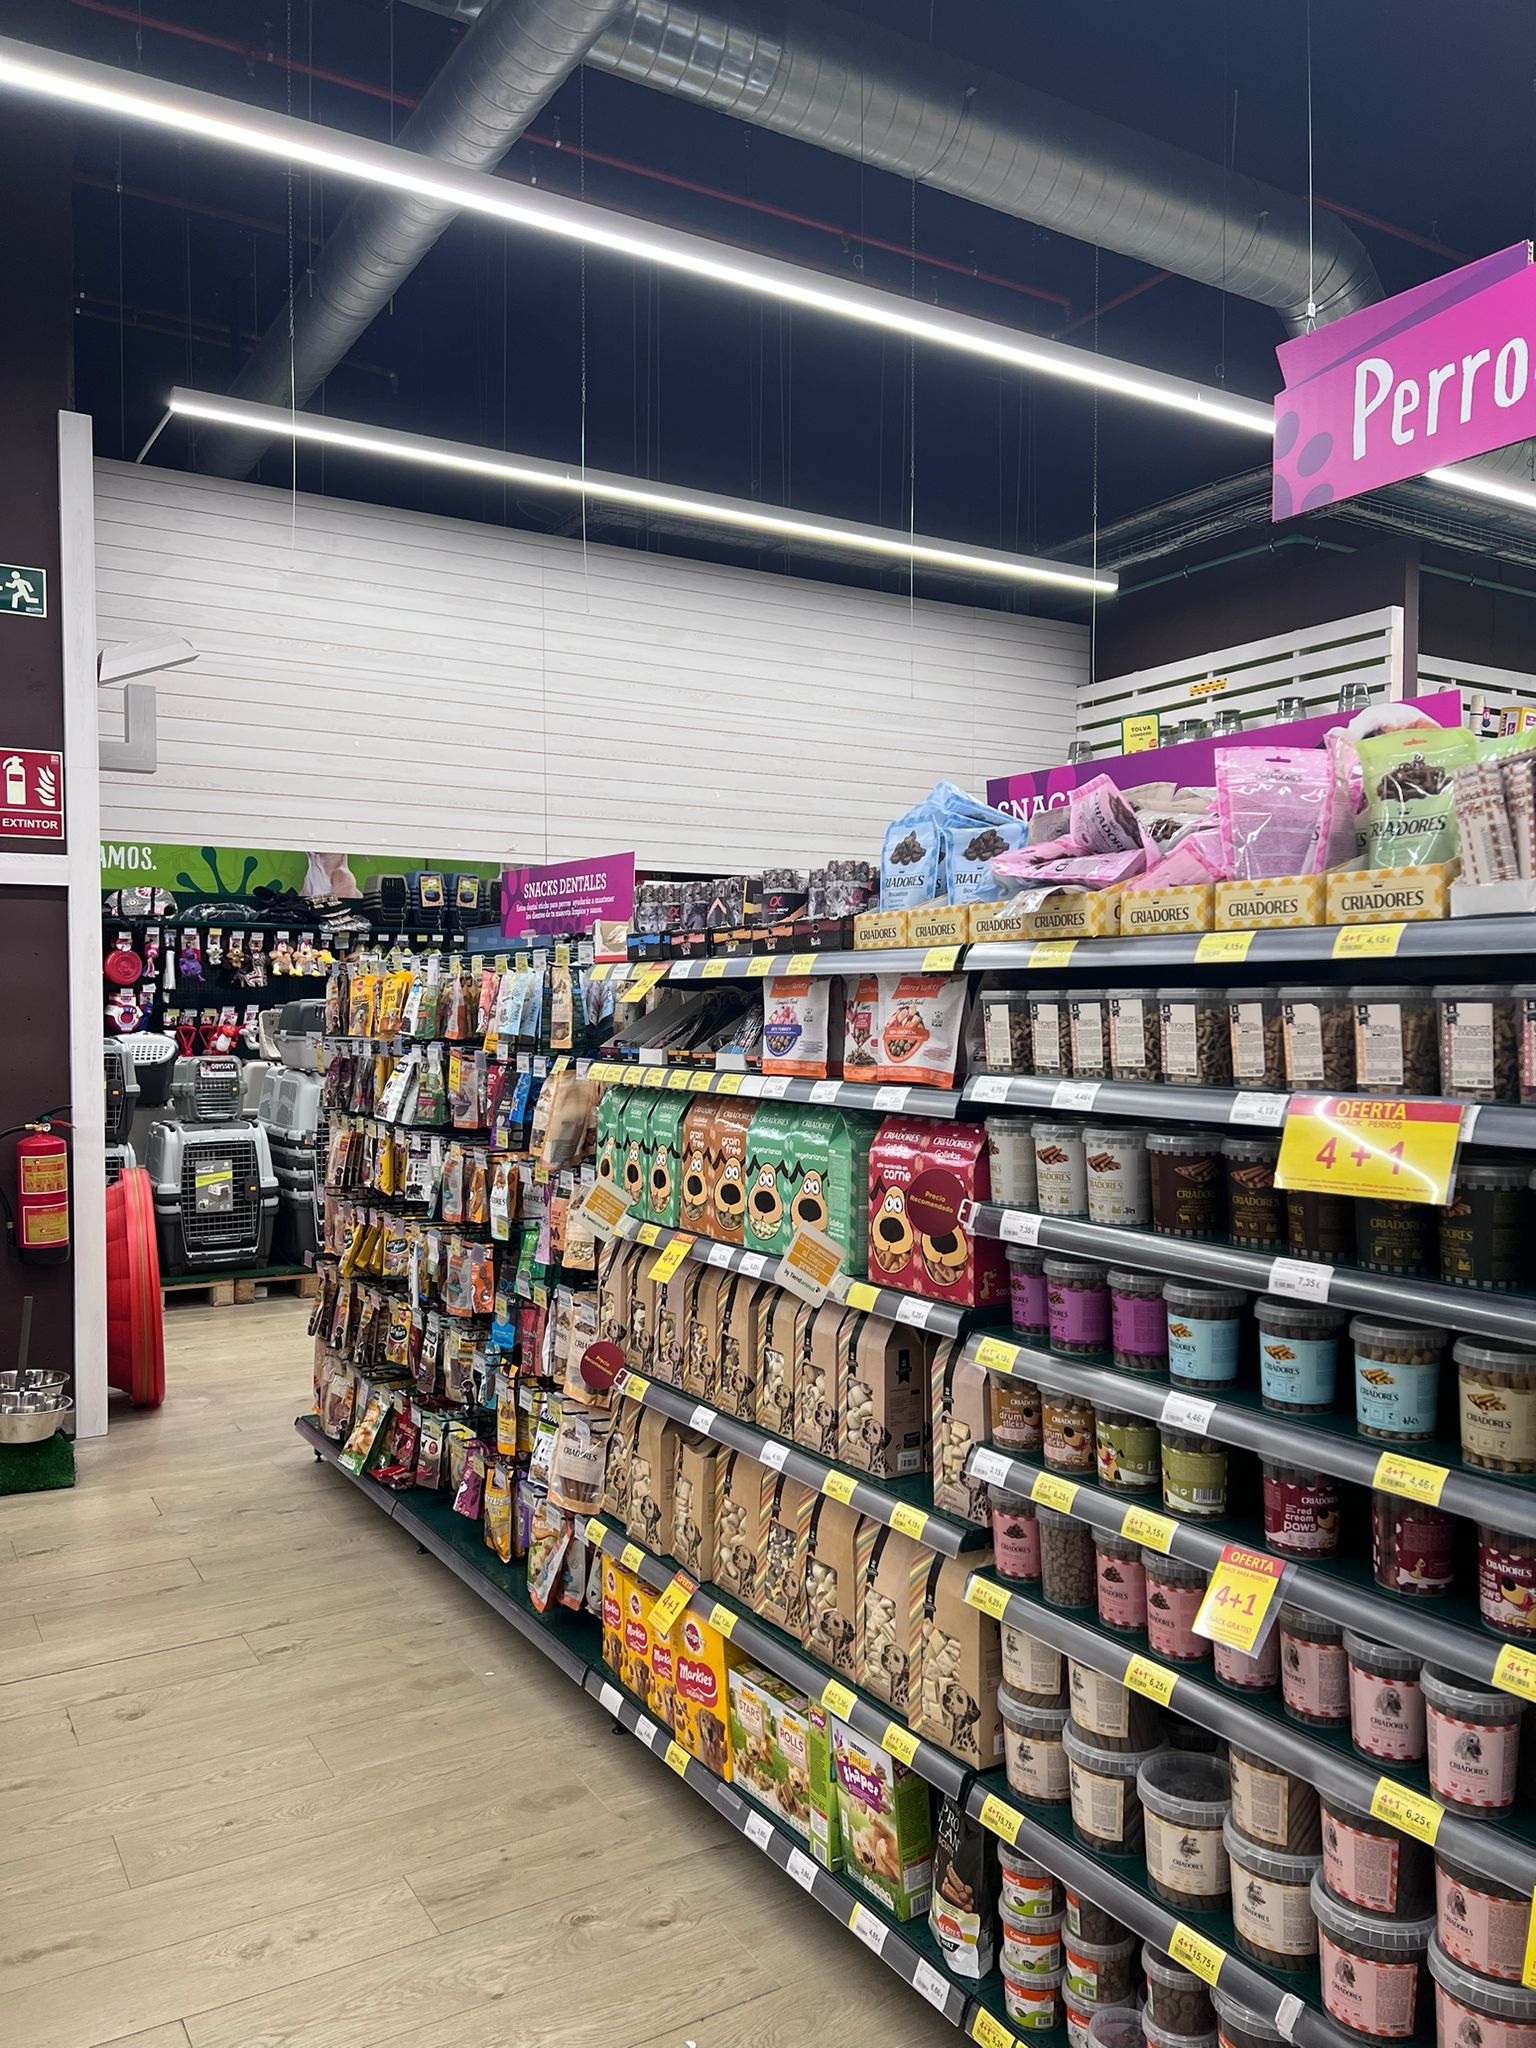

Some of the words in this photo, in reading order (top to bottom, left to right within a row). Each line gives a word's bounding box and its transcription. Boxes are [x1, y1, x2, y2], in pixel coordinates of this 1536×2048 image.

[1353, 336, 1536, 461] Perro
[1130, 725, 1152, 733] TOLVA
[2, 817, 59, 831] EXTINTOR
[1370, 814, 1447, 838] RIADORES
[523, 879, 558, 899] SNACKS
[559, 872, 607, 894] DENTALES
[1228, 899, 1298, 917] CRIADORES
[1341, 890, 1424, 911] CRIADORES
[1034, 912, 1085, 929] CRIADORES
[1130, 907, 1189, 924] CRIADORES
[915, 923, 956, 938] CRIADORES
[976, 917, 1022, 932] CRIADORES
[859, 926, 897, 942] CRIADORES
[1341, 934, 1361, 943] 4+1
[1335, 1101, 1407, 1120] OFERTA
[758, 1115, 790, 1126] CRIADORES
[1367, 1120, 1403, 1130] PERROS
[689, 1130, 705, 1140] grain
[721, 1136, 741, 1148] grain
[883, 1131, 920, 1143] CRIADORES
[933, 1136, 974, 1149] CRIADORES
[692, 1138, 705, 1149] free
[725, 1144, 742, 1155] free
[751, 1145, 783, 1156] vegetarianas
[794, 1151, 829, 1163] vegetarianas
[1316, 1137, 1337, 1169] 4
[1388, 1141, 1405, 1175] 1
[883, 1168, 912, 1182] carne
[909, 1194, 954, 1214] Recomendado
[924, 1190, 946, 1202] Precio
[662, 1251, 681, 1266] 4+1
[1297, 1277, 1321, 1289] 7,35€
[584, 1355, 613, 1377] Recomendado
[595, 1355, 610, 1367] Precio
[1359, 1386, 1399, 1402] CRIADORES
[999, 1410, 1023, 1421] drum
[1466, 1412, 1512, 1429] CRIADORES
[1002, 1420, 1025, 1430] sticks
[1384, 1466, 1405, 1478] 4+1
[1409, 1476, 1435, 1491] 4,46€
[1038, 1481, 1051, 1491] 4+1
[1053, 1490, 1070, 1502] 6,25€
[1285, 1513, 1314, 1522] cream
[1296, 1506, 1312, 1516] red
[1128, 1517, 1144, 1528] 4+1
[1146, 1525, 1165, 1539] 3,15€
[1283, 1520, 1317, 1532] paws
[1230, 1551, 1274, 1573] OFERTA
[1485, 1559, 1533, 1578] CRIADORES
[974, 1587, 987, 1598] 4+1
[1215, 1585, 1257, 1616] 4+1
[662, 1595, 680, 1616] 4+1
[626, 1623, 646, 1642] Markies
[679, 1663, 713, 1687] Markies
[1506, 1662, 1531, 1677] 4+1
[1132, 1667, 1148, 1679] 4+1
[1149, 1678, 1168, 1693] 6,25€
[738, 1701, 760, 1721] STARS
[1370, 1716, 1409, 1730] CRIADORES
[780, 1728, 804, 1752] ROLLS
[1450, 1761, 1489, 1776] CRIADORES
[843, 1766, 879, 1796] Shapes
[942, 1803, 960, 1833] PRO
[987, 1805, 1001, 1818] 4+1
[998, 1814, 1015, 1832] 15,75€
[1380, 1793, 1401, 1809] 4+1
[1405, 1809, 1432, 1830] 6,25€
[1172, 1858, 1204, 1870] CRIADORES
[1242, 1903, 1271, 1923] CRIADORES
[1443, 1913, 1474, 1937] CRIADORES
[1178, 1936, 1194, 1953] 4+1
[1192, 1949, 1216, 1970] 15,75€
[1331, 1980, 1363, 2002] CRIADORES
[979, 2020, 991, 2035] 4+1
